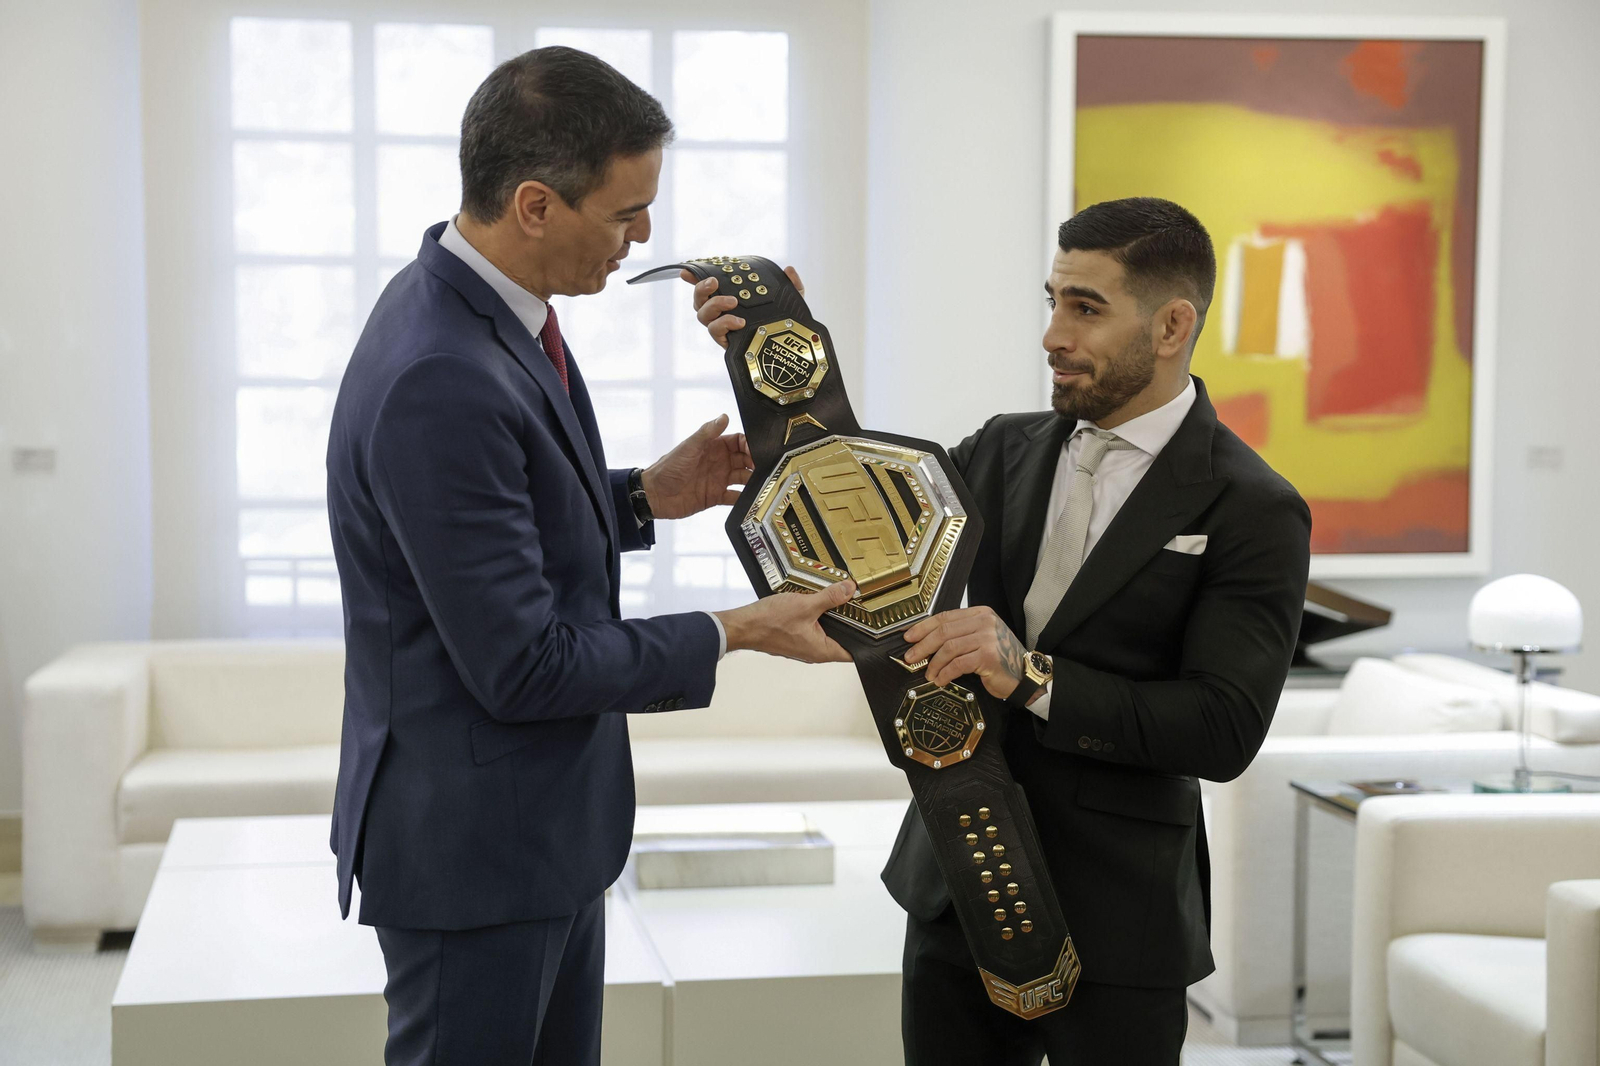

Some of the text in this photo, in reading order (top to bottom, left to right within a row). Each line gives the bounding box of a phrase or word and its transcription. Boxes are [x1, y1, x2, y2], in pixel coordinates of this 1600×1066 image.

[771, 343, 809, 369] WORLD
[783, 336, 807, 354] UFC
[763, 347, 811, 378] CHAMPION
[807, 461, 900, 561] UFC
[789, 523, 809, 554] MCMXCIII
[922, 706, 965, 731] WORLD
[932, 697, 962, 716] UFC
[913, 712, 966, 741] CHAMPION
[1019, 978, 1064, 1013] UFC
